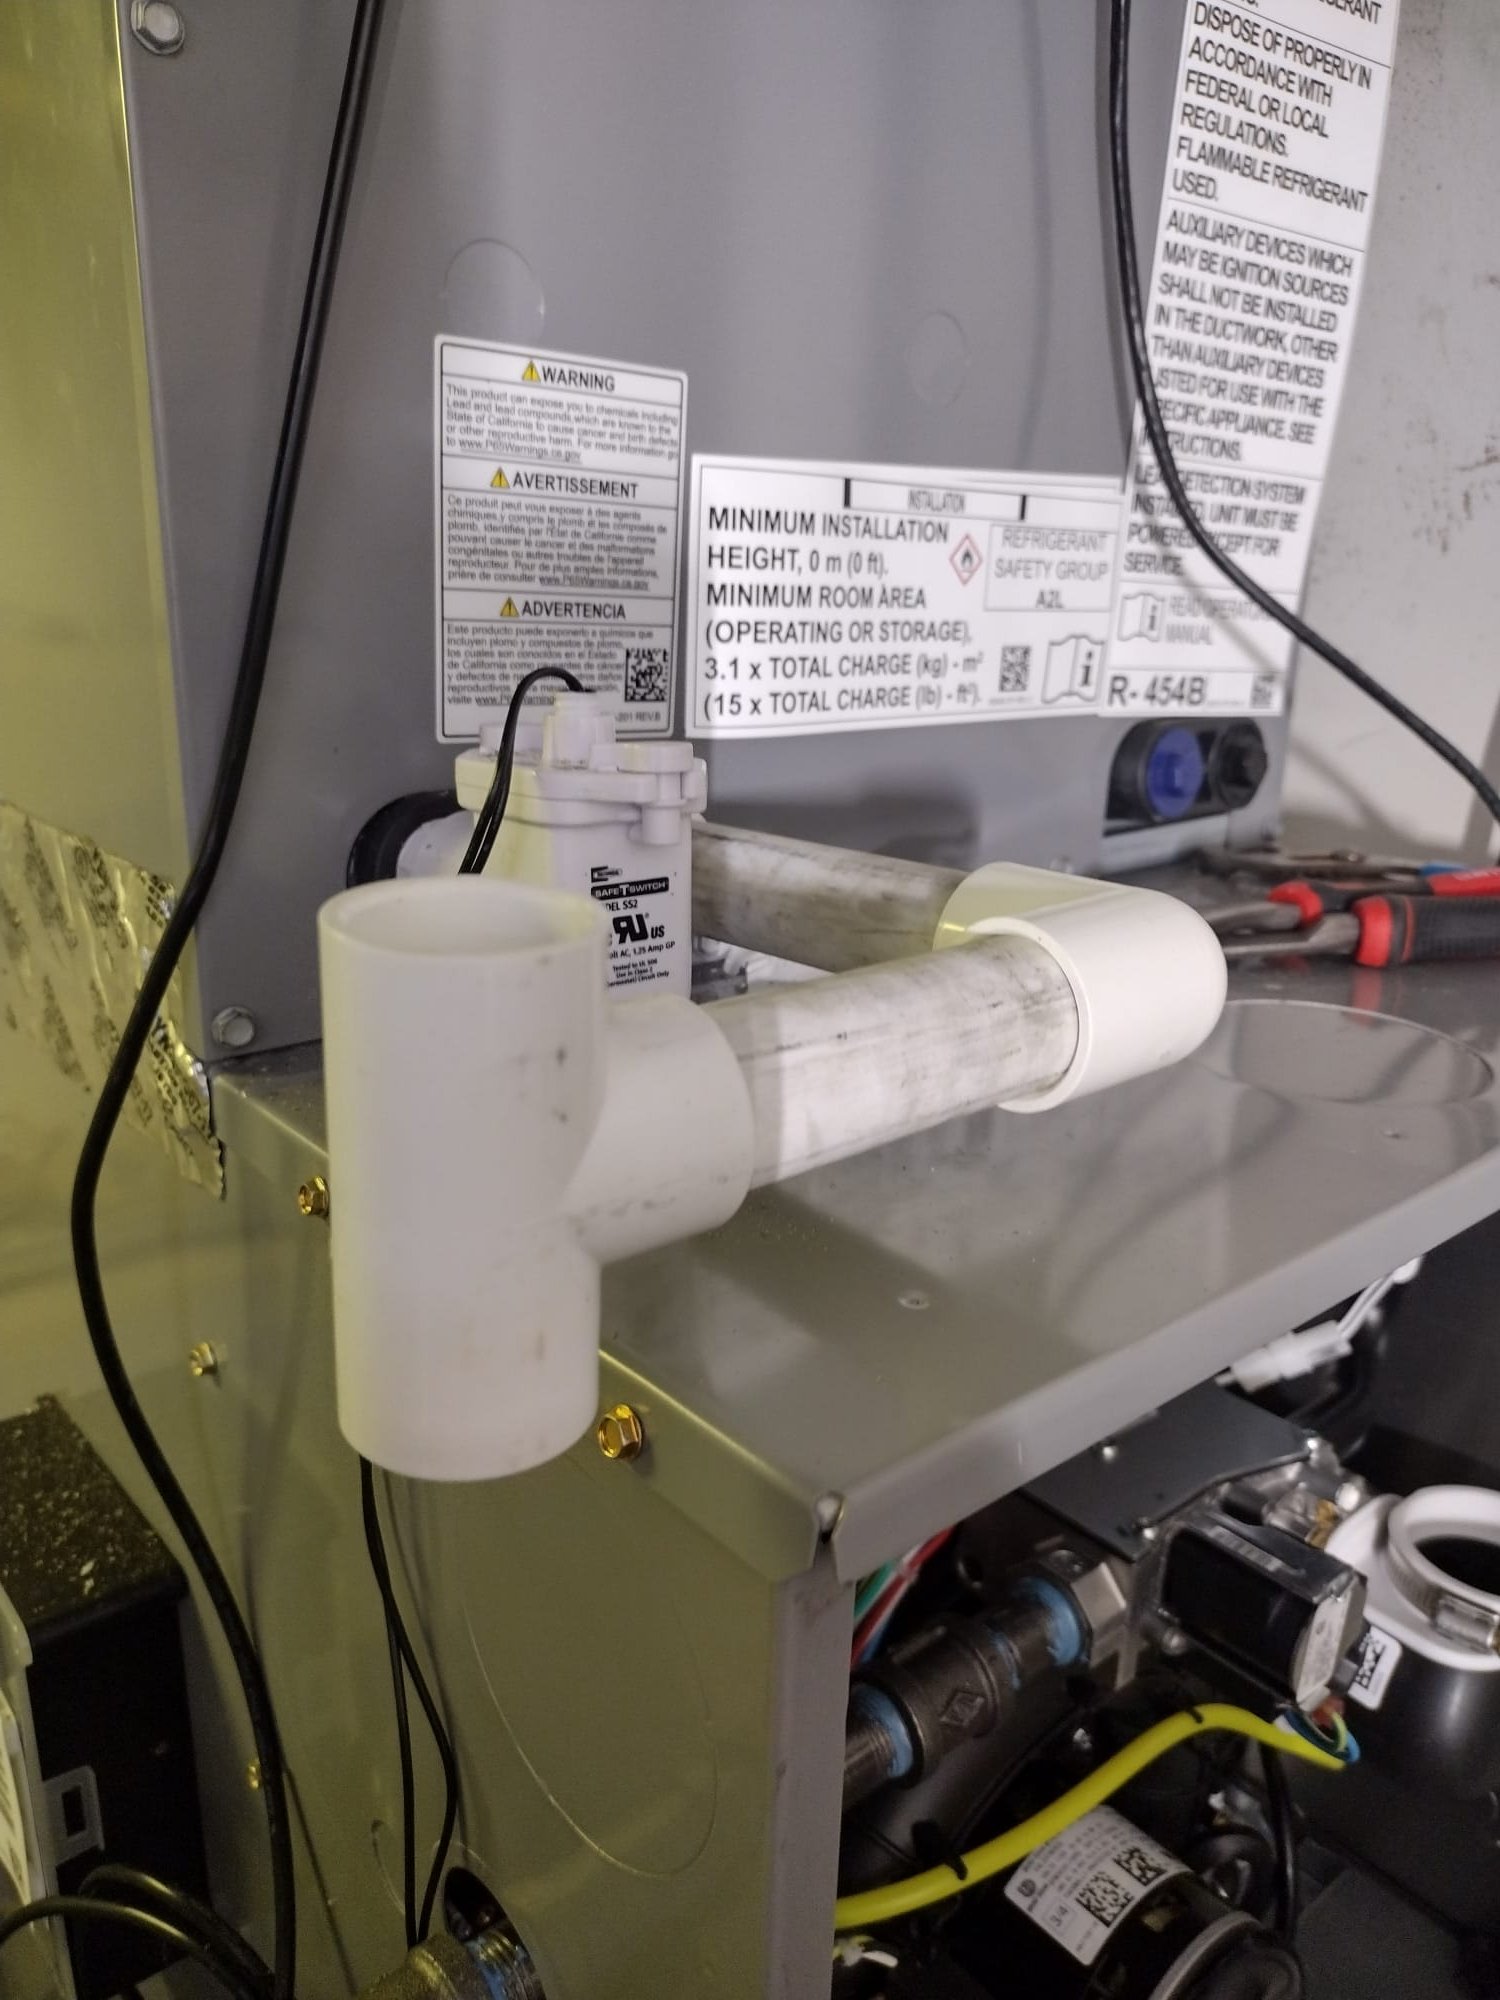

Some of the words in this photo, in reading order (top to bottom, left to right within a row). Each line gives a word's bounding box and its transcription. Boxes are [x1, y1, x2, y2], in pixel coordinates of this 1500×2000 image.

[1194, 2, 1261, 46] DISPOSE
[1262, 29, 1283, 52] OF
[1284, 37, 1358, 83] PROPERLY
[1357, 65, 1372, 89] IN
[1188, 35, 1297, 94] ACCORDANCE
[1299, 77, 1333, 107] WITH
[1185, 69, 1257, 112] FEDERAL
[1258, 95, 1281, 119] OR
[1283, 102, 1329, 138] LOCAL
[1180, 103, 1289, 157] REGULATIONS.
[1172, 168, 1219, 202] USED.
[1176, 135, 1270, 184] FLAMMABLE
[1272, 163, 1368, 213] REFRIGERANT
[1166, 209, 1246, 248] AUXILIARY
[1245, 230, 1307, 265] DEVICES
[1308, 246, 1354, 278] WHICH
[1162, 241, 1198, 267] MAY
[1198, 250, 1221, 275] BE
[1221, 255, 1282, 291] IGNITION
[1282, 270, 1350, 306] SOURCES
[1158, 272, 1207, 304] SHALL
[1210, 284, 1241, 311] NOT
[1241, 292, 1263, 316] BE
[1264, 298, 1338, 333] INSTALLED
[1154, 304, 1171, 327] IN
[1175, 307, 1202, 334] THE
[1290, 333, 1338, 363] OTHER
[1152, 334, 1193, 362] THAN
[1192, 342, 1265, 376] AUXILIARY
[1266, 358, 1326, 389] DEVICES
[541, 365, 616, 392] WARNING
[446, 383, 468, 397] This
[471, 387, 508, 402] product
[1200, 375, 1228, 400] FOR
[1230, 380, 1259, 407] USE
[1260, 386, 1296, 412] WITH
[1297, 394, 1326, 418] THE
[446, 409, 473, 422] State
[475, 414, 485, 424] of
[487, 415, 534, 430] California
[536, 420, 545, 430] to
[474, 402, 492, 413] and
[445, 435, 456, 447] to
[446, 425, 456, 434] or
[459, 425, 484, 436] other
[1287, 421, 1317, 445] SEE
[512, 472, 640, 499] AVERTISSEMENT
[1253, 479, 1307, 505] SYSTEM
[448, 494, 462, 505] Ce
[465, 495, 498, 509] produit
[1209, 502, 1242, 524] UNIT
[1244, 506, 1280, 528] MUST
[708, 506, 816, 536] MINIMUM
[822, 512, 949, 543] INSTALLATION
[1002, 527, 1109, 552] REFRIGERANT
[708, 545, 803, 576] HEIGHT,
[809, 549, 820, 573] 0
[825, 555, 841, 574] m
[847, 551, 863, 580] (0
[994, 557, 1053, 580] SAFETY
[1055, 560, 1109, 582] GROUP
[522, 600, 626, 619] ADVERTENCIA
[707, 583, 812, 608] MINIMUM
[819, 585, 874, 609] ROOM
[878, 586, 926, 609] AREA
[1035, 589, 1065, 610] A2L
[447, 623, 469, 634] Este
[472, 624, 514, 637] producto
[705, 619, 843, 650] (OPERATING
[848, 620, 874, 643] OR
[704, 656, 739, 680] 3.1
[749, 662, 761, 680] x
[769, 656, 832, 680] TOTAL
[838, 653, 912, 677] CHARGE
[916, 653, 948, 679] (kg)
[703, 692, 742, 722] (15
[749, 698, 762, 716] x
[769, 690, 832, 715] TOTAL
[837, 685, 911, 711] CHARGE
[915, 684, 942, 711] (lb)
[650, 924, 665, 939] US
[647, 944, 664, 953] Amp
